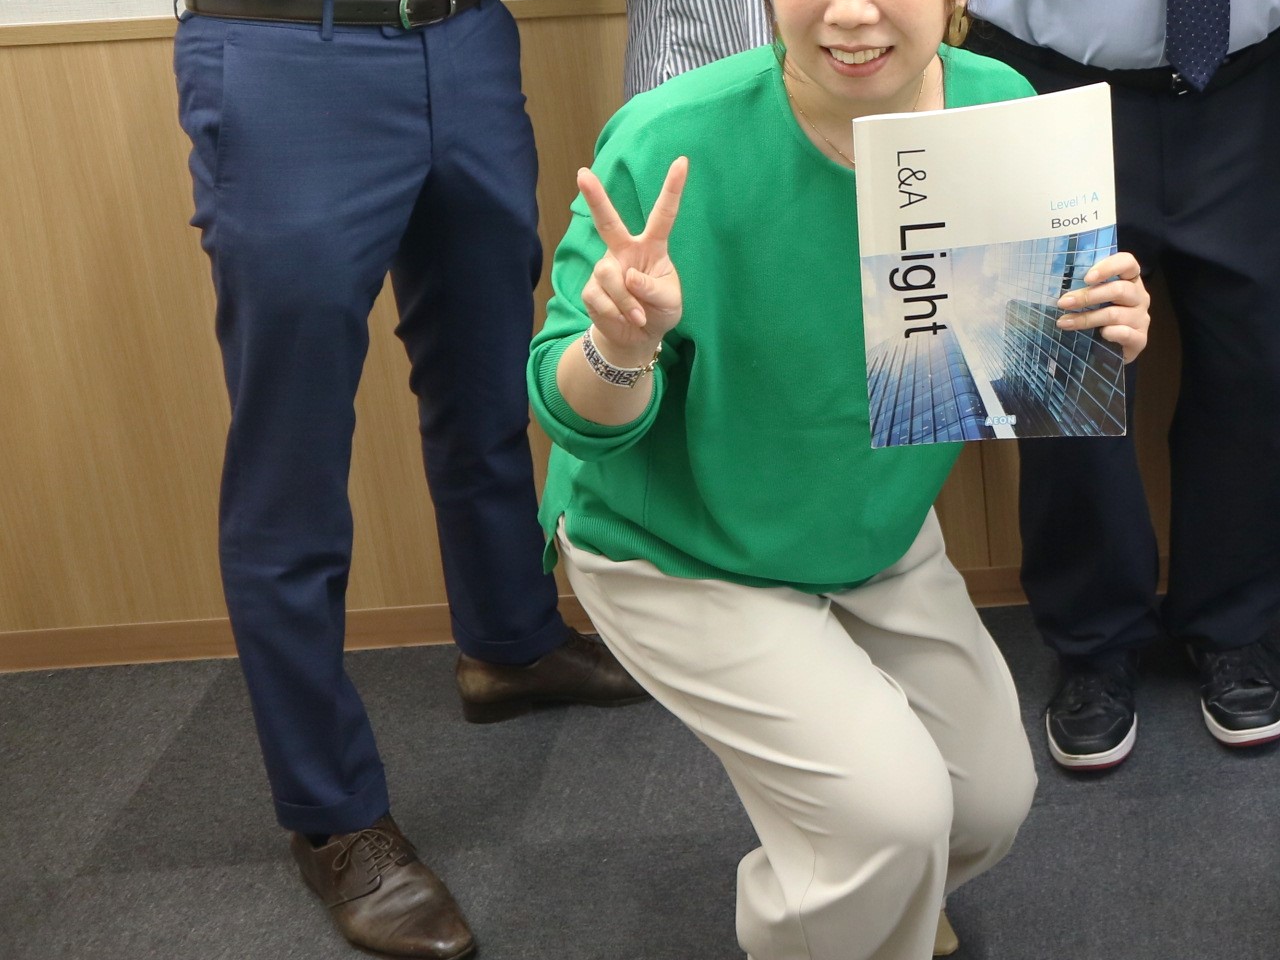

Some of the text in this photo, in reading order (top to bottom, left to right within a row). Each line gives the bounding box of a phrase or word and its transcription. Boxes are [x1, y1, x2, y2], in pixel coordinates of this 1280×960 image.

[1050, 195, 1079, 211] Level
[1091, 191, 1099, 202] A
[1051, 209, 1098, 229] Book 1
[889, 149, 949, 339] L&A Light
[985, 415, 1016, 426] AEON
